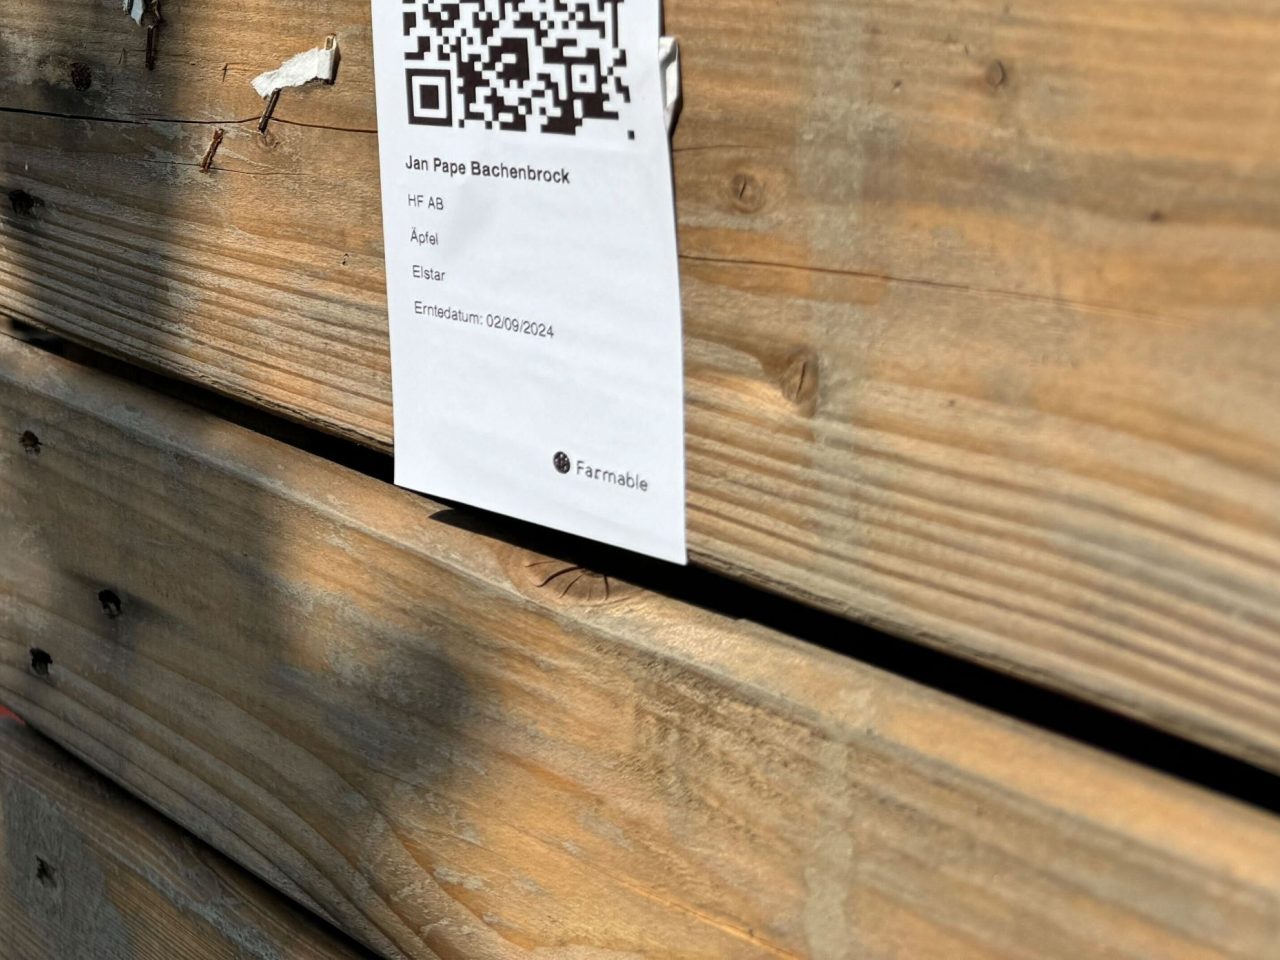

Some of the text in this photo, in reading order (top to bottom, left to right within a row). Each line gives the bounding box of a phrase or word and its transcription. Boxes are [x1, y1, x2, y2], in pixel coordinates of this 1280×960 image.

[405, 155, 570, 184] Jan Pape Bachenbrock
[408, 194, 444, 211] HF AB
[410, 227, 439, 246] Äpfel
[412, 265, 446, 282] Elstar
[414, 301, 555, 338] Erntedatum: 02/09/2024
[576, 460, 648, 492] Farmable
